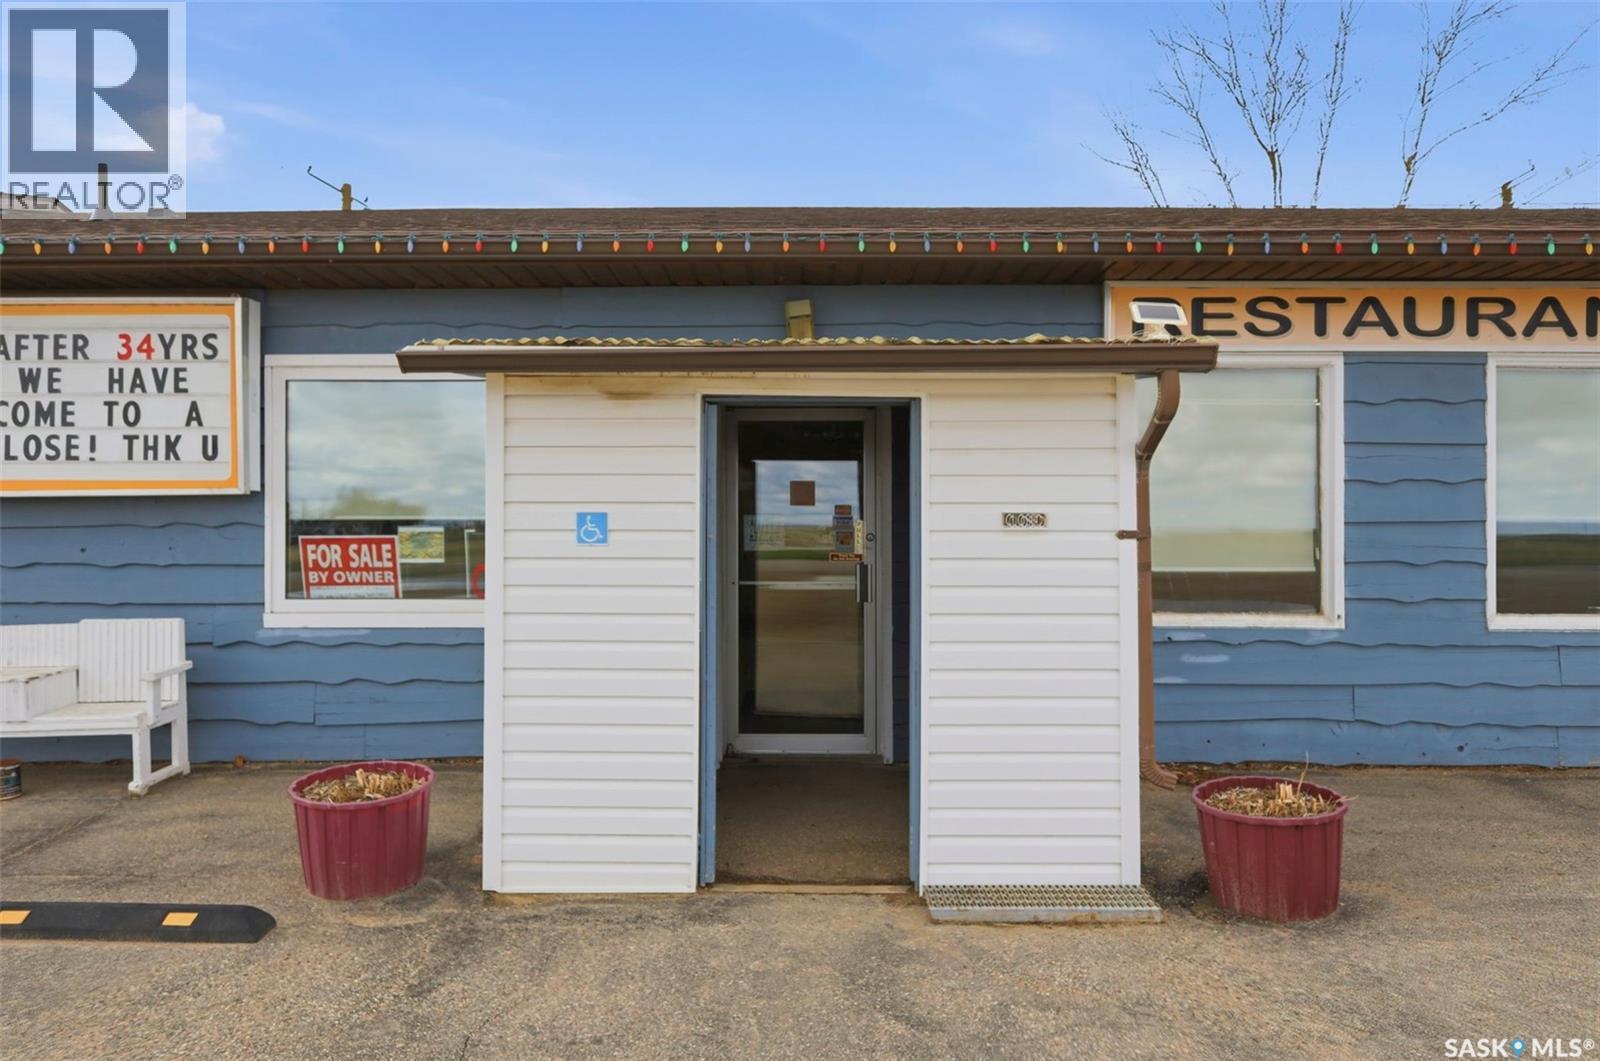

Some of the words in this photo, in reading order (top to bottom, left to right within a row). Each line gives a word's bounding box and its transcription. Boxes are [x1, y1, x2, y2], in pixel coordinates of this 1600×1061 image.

[1131, 296, 1600, 338] ESTAURA
[0, 333, 90, 361] AFTER
[18, 367, 62, 394] WE
[107, 367, 189, 394] HAVE
[103, 400, 141, 427] TO
[185, 400, 204, 427] A
[123, 434, 182, 462] THK
[201, 434, 219, 462] U
[306, 543, 343, 568] FOR
[347, 543, 394, 568] SALE
[308, 571, 328, 584] BY
[333, 570, 395, 584] OWNER
